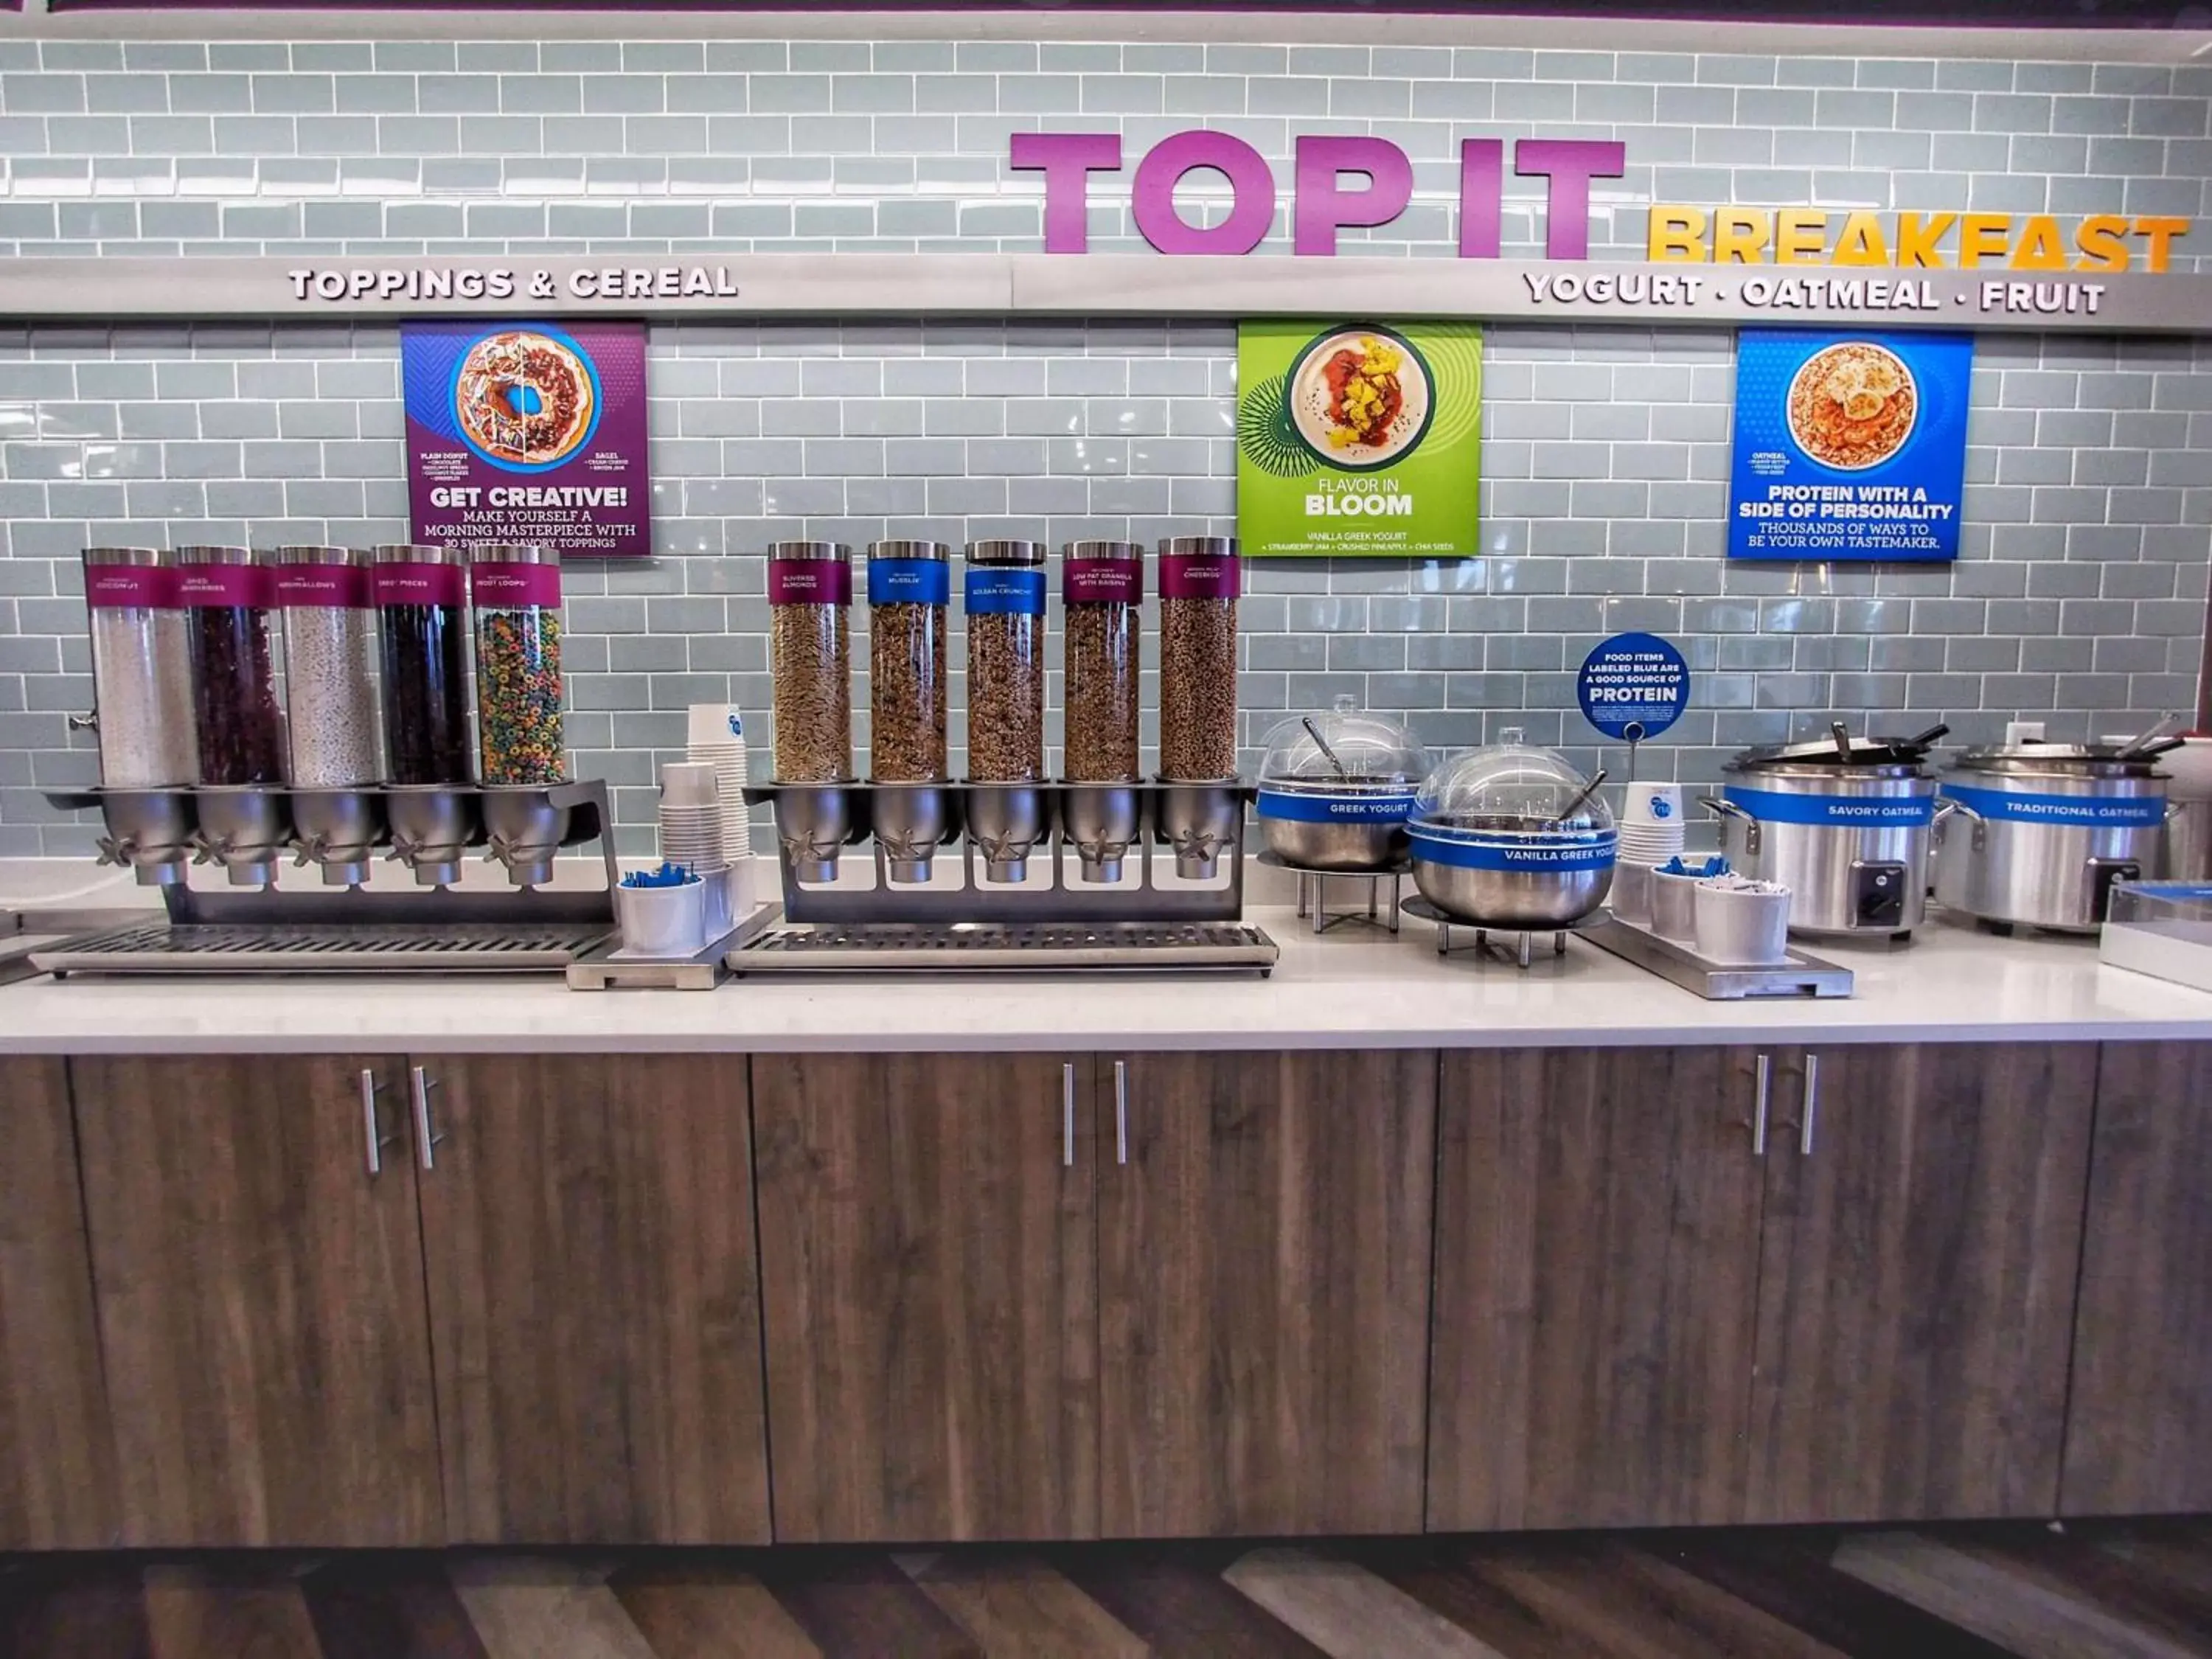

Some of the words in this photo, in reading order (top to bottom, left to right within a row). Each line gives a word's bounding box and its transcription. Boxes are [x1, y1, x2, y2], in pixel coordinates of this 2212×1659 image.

[1011, 130, 1414, 256] TOP
[1459, 138, 1626, 260] IT
[1649, 205, 2194, 274] BREAKFAST
[289, 269, 514, 299] TOPPINGS
[528, 269, 557, 299] &
[568, 266, 738, 298] CEREAL
[1523, 273, 1703, 305] YOGURT
[1740, 278, 1942, 311] OATMEAL
[1980, 280, 2106, 315] FRUIT
[1319, 478, 1379, 493] FLAVOR
[1383, 478, 1399, 492] IN
[430, 487, 481, 508] GET
[488, 487, 627, 507] CREATIVE!
[1768, 485, 1854, 501] PROTEIN
[1858, 486, 1909, 501] WITH
[1912, 487, 1927, 502] A
[1305, 494, 1413, 516] BLOOM
[1739, 502, 1785, 518] SIDE
[1789, 503, 1817, 518] OF
[1820, 504, 1953, 519] PERSONALITY
[463, 511, 505, 523] MAKE
[507, 511, 579, 523] YOURSELF
[582, 511, 592, 522] A
[425, 524, 493, 537] MORNING
[496, 525, 593, 537] MASTERPIECE
[596, 525, 636, 536] WITH
[1759, 522, 1845, 535] THOUSANDS
[1848, 523, 1867, 535] OF
[1869, 524, 1907, 535] WAYS
[1911, 524, 1930, 535] TO
[1307, 532, 1343, 540] VANILLA
[1344, 532, 1372, 540] GREEK
[1373, 532, 1408, 540] YOGURT
[1748, 535, 1766, 547] BE
[1769, 535, 1807, 547] YOUR
[1809, 535, 1845, 548] OWN
[1847, 536, 1941, 549] TASTEMAKER.
[445, 538, 459, 549] 30
[514, 538, 558, 548] SAVORY
[559, 538, 616, 549] TOPPINGS
[1605, 653, 1632, 661] FOOD
[1589, 664, 1631, 672] LABELED
[1586, 675, 1593, 684] A
[1595, 675, 1624, 684] GOOD
[1668, 675, 1682, 683] OF
[1589, 687, 1677, 702] PROTEIN
[1329, 804, 1366, 813] GREEK
[1368, 803, 1408, 813] YOGURT
[1829, 805, 1880, 817] SAVORY
[2006, 801, 2096, 817] TRADITIONAL
[1505, 850, 1558, 860] VANILLA
[1561, 849, 1593, 860] GREEK
